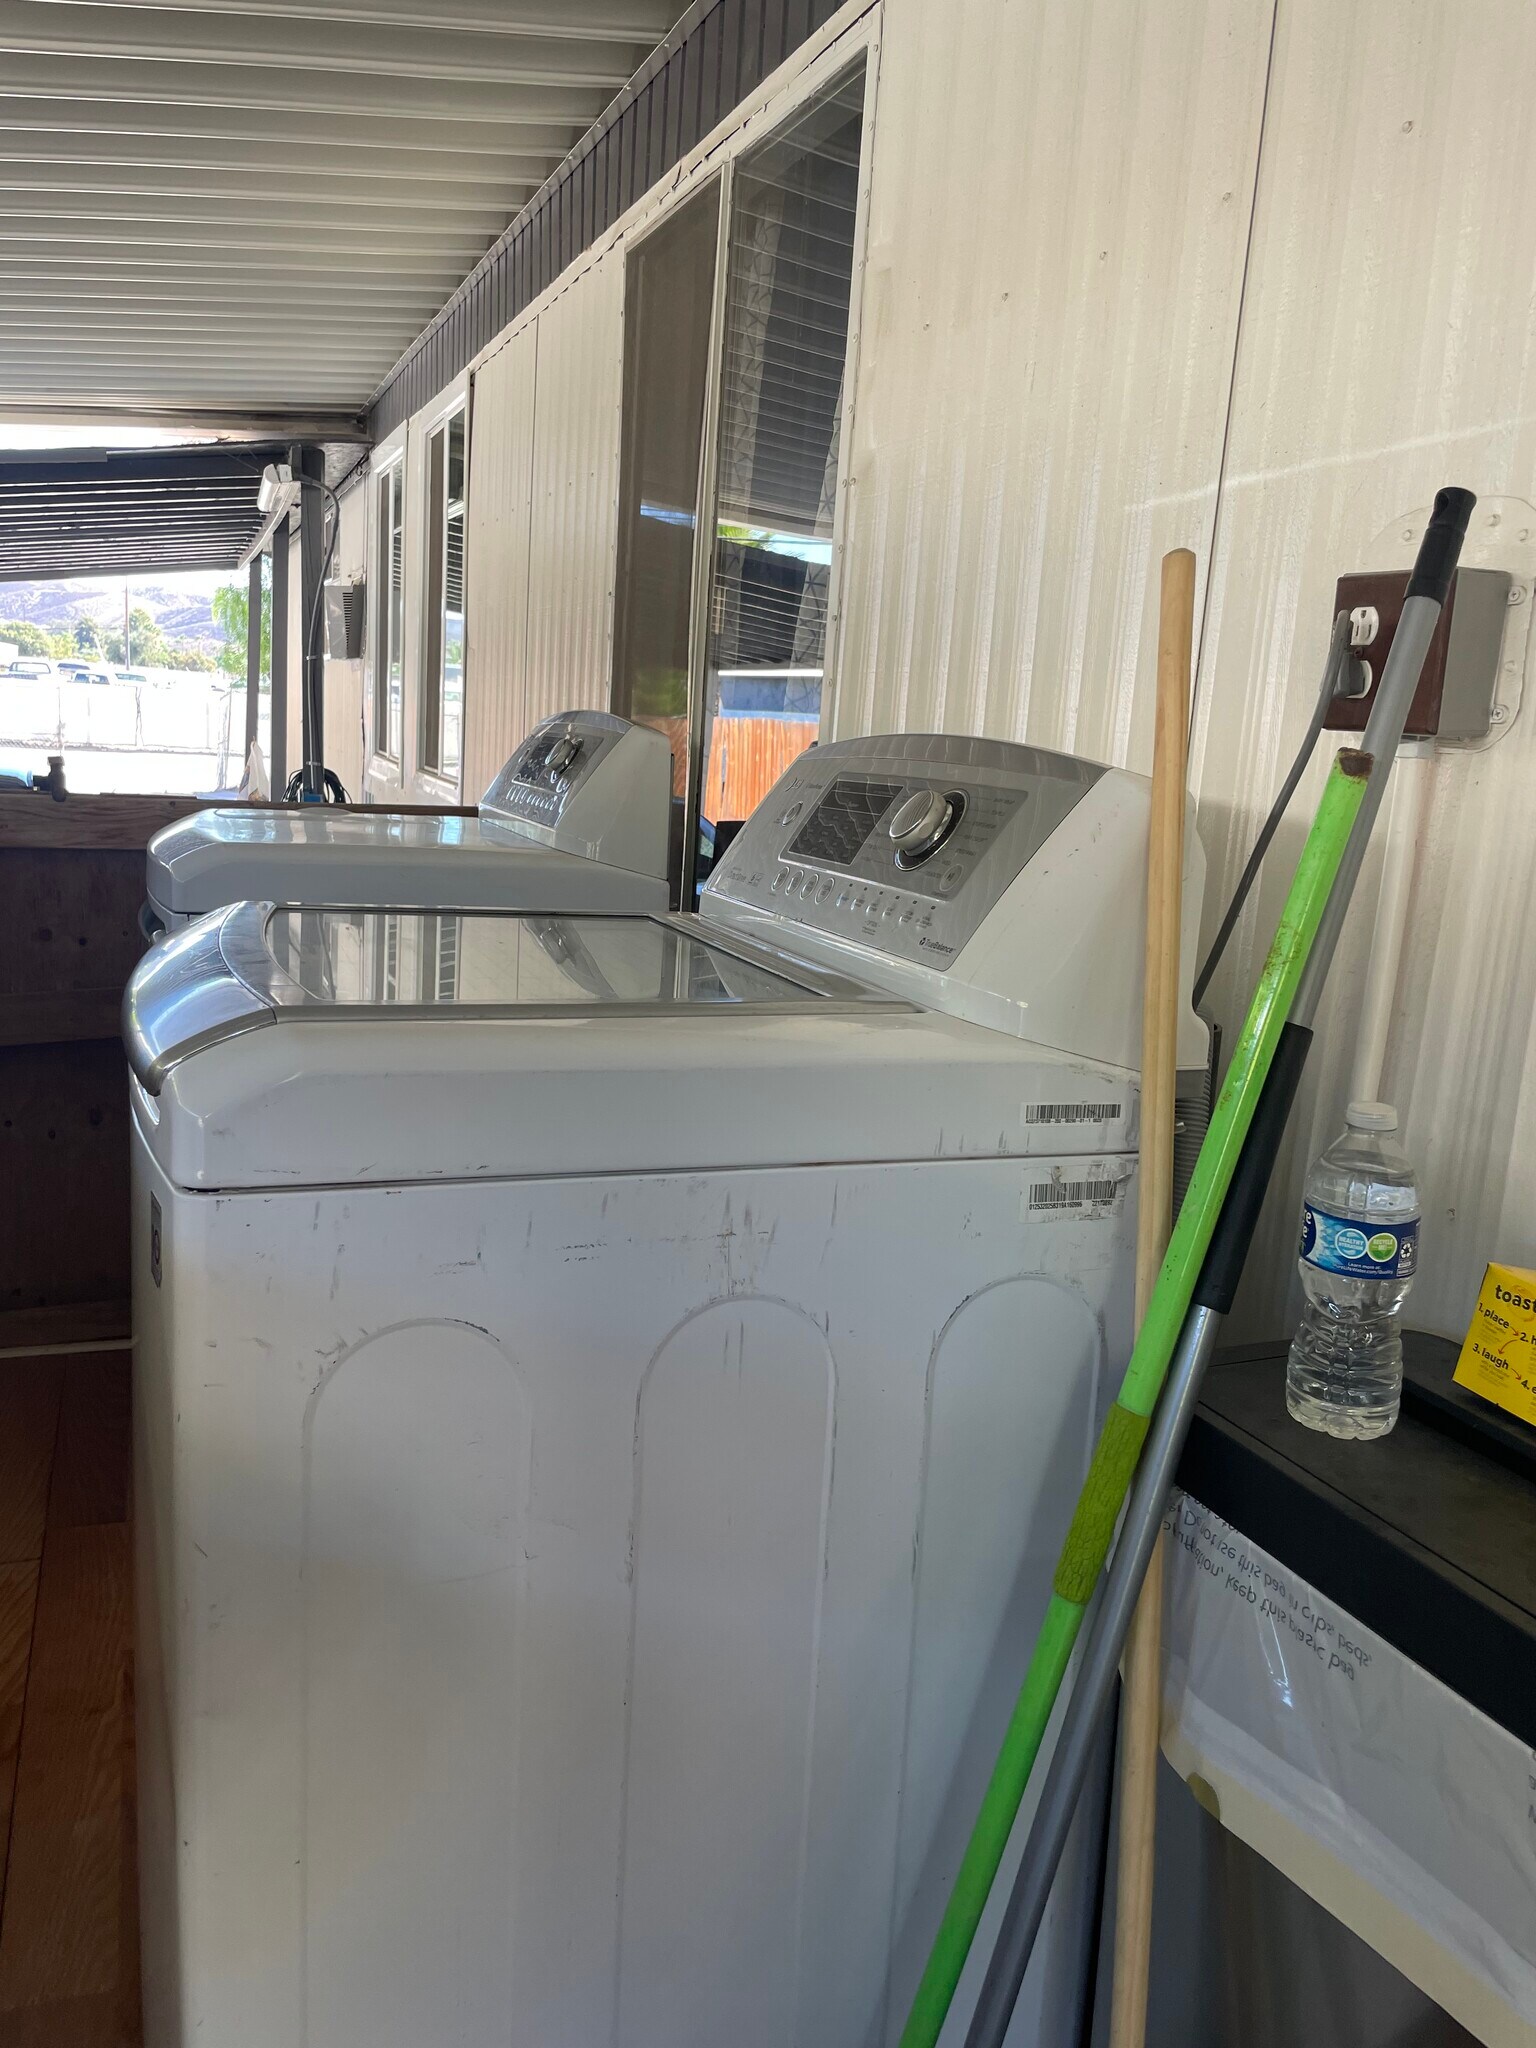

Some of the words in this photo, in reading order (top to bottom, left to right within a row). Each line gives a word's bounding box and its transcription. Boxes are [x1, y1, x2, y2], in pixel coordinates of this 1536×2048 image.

[924, 938, 954, 953] TrueBalance
[1338, 1236, 1364, 1246] HEALTHY
[1478, 1302, 1484, 1313] 1.
[1483, 1308, 1510, 1329] place
[1520, 1332, 1529, 1343] 2.
[1472, 1343, 1480, 1354] 3.
[1481, 1347, 1509, 1370] laugh
[1521, 1379, 1530, 1391] 4.
